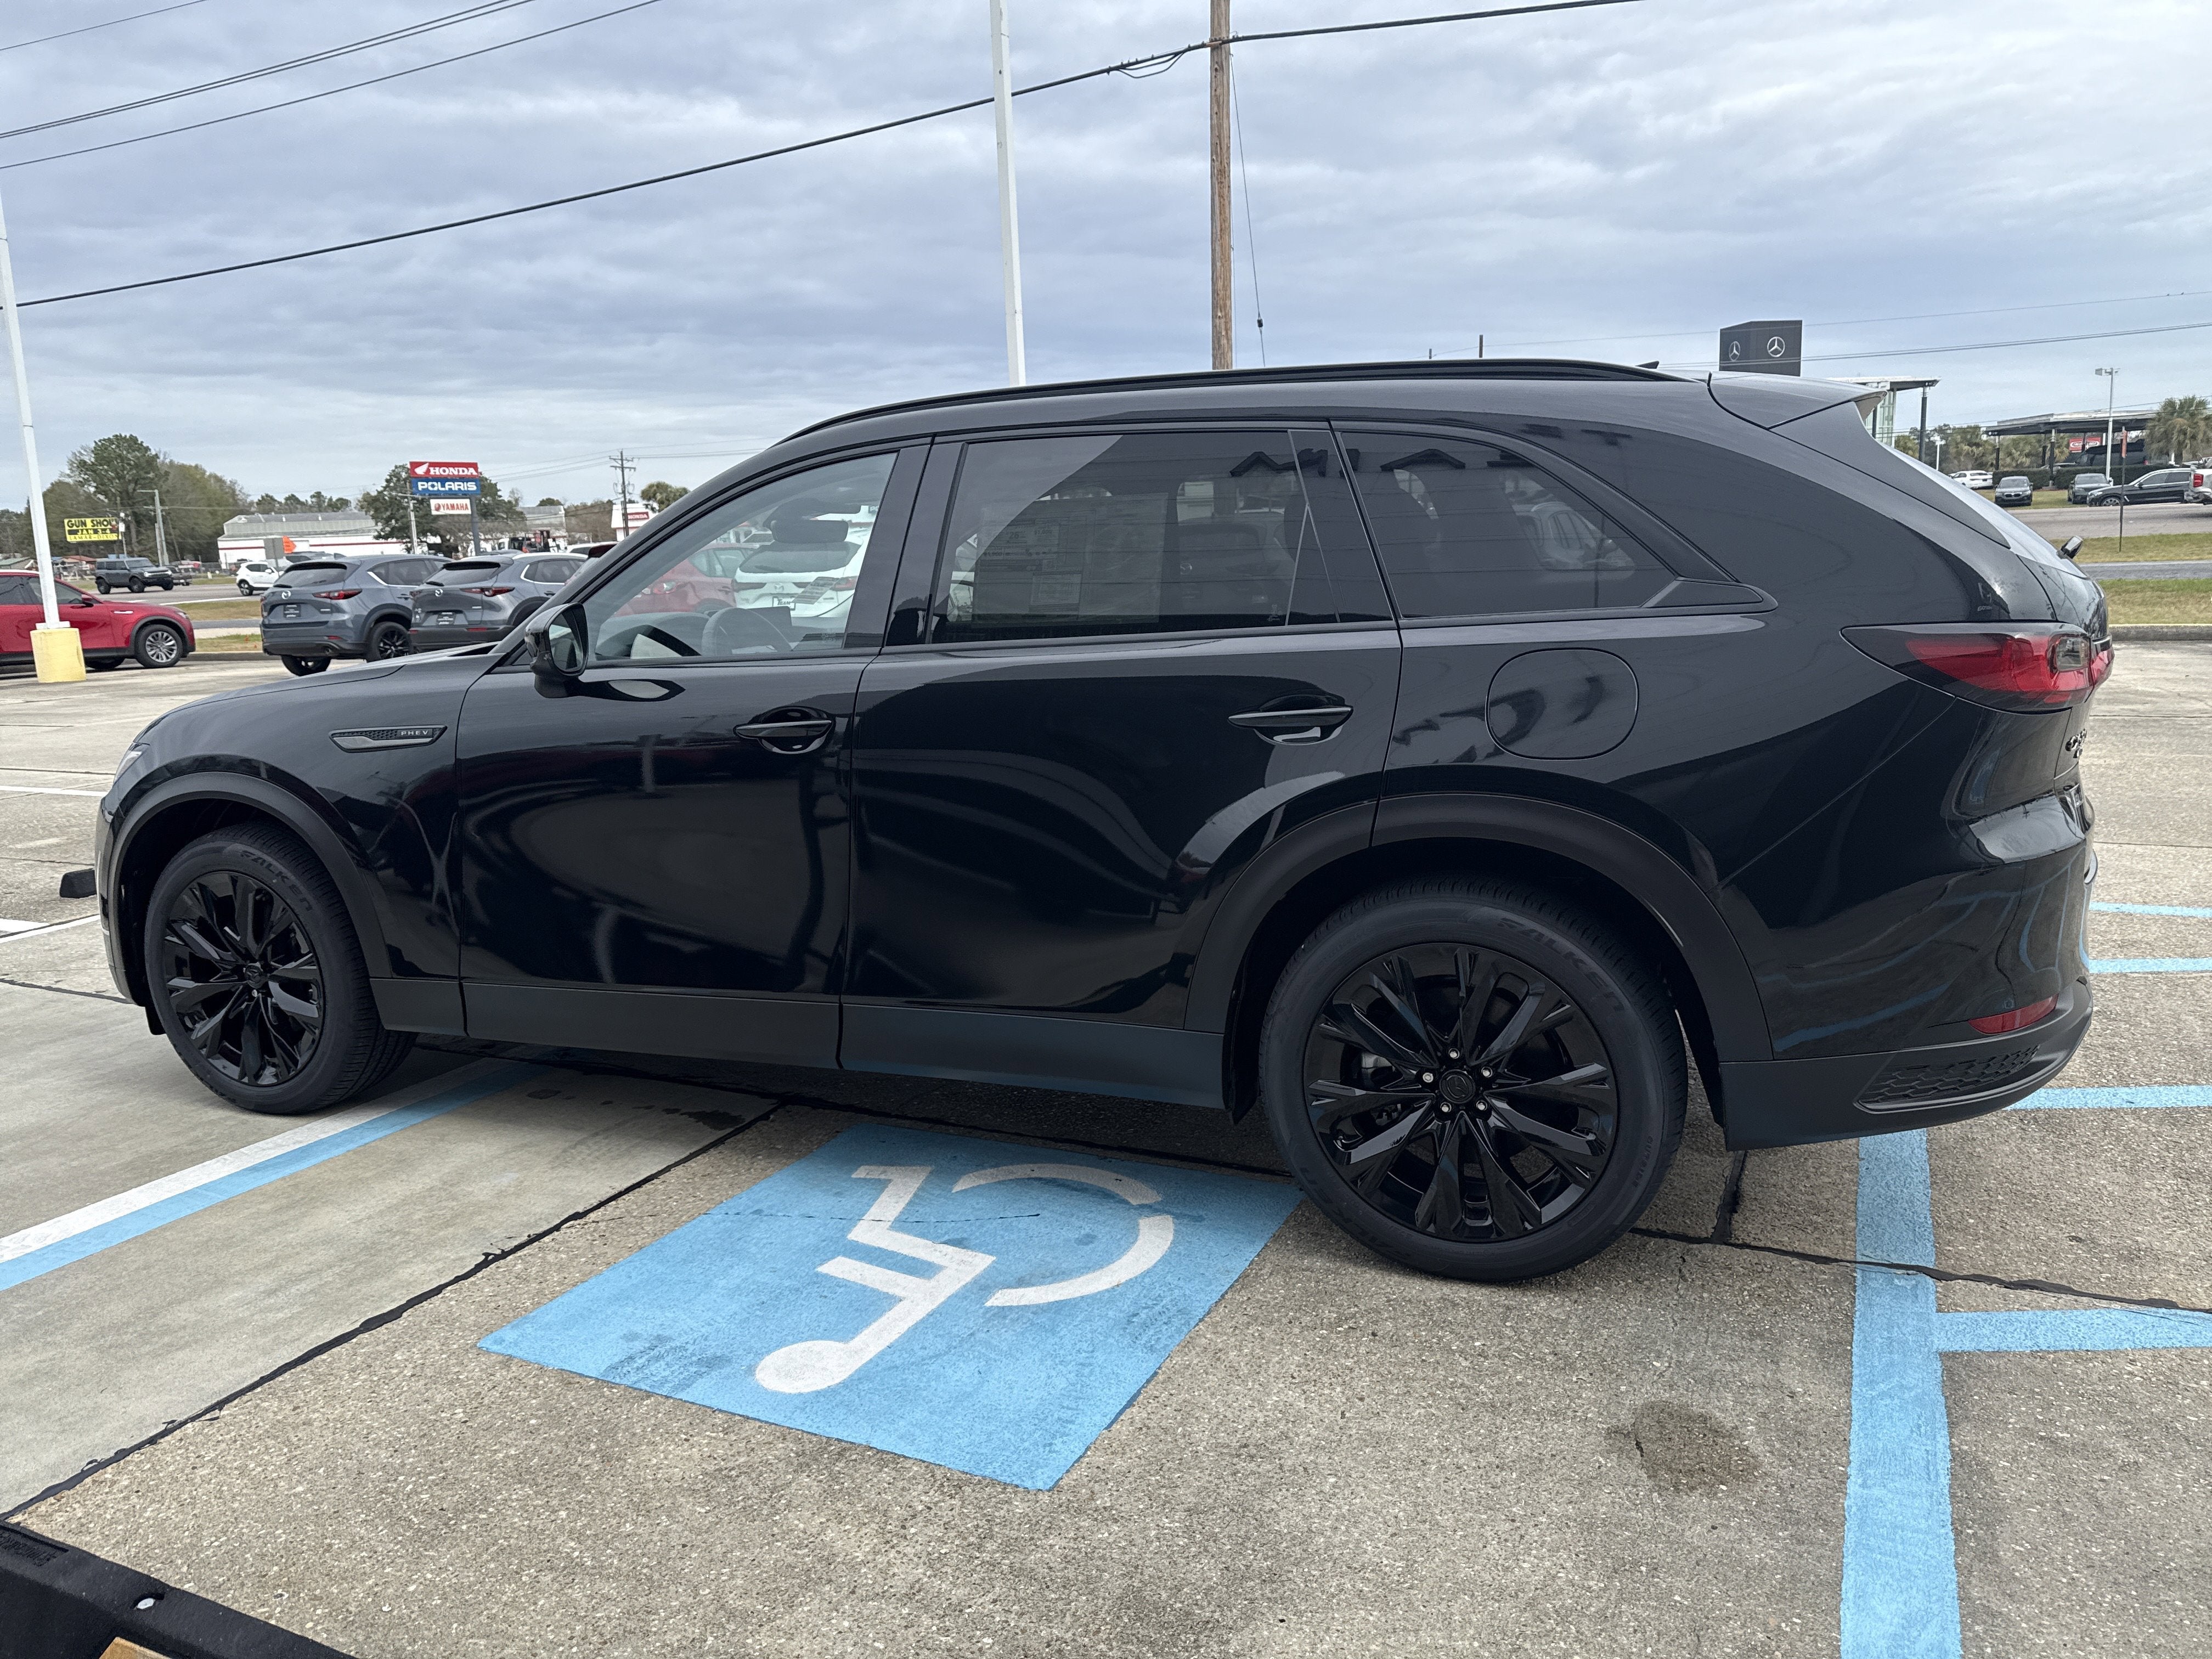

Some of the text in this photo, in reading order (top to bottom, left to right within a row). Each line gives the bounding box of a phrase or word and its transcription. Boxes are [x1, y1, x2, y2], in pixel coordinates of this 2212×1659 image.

[417, 482, 477, 491] POLARIS
[67, 520, 87, 528] GUN
[240, 850, 313, 911] FALKEN
[1496, 917, 1624, 1011] FALKEN
